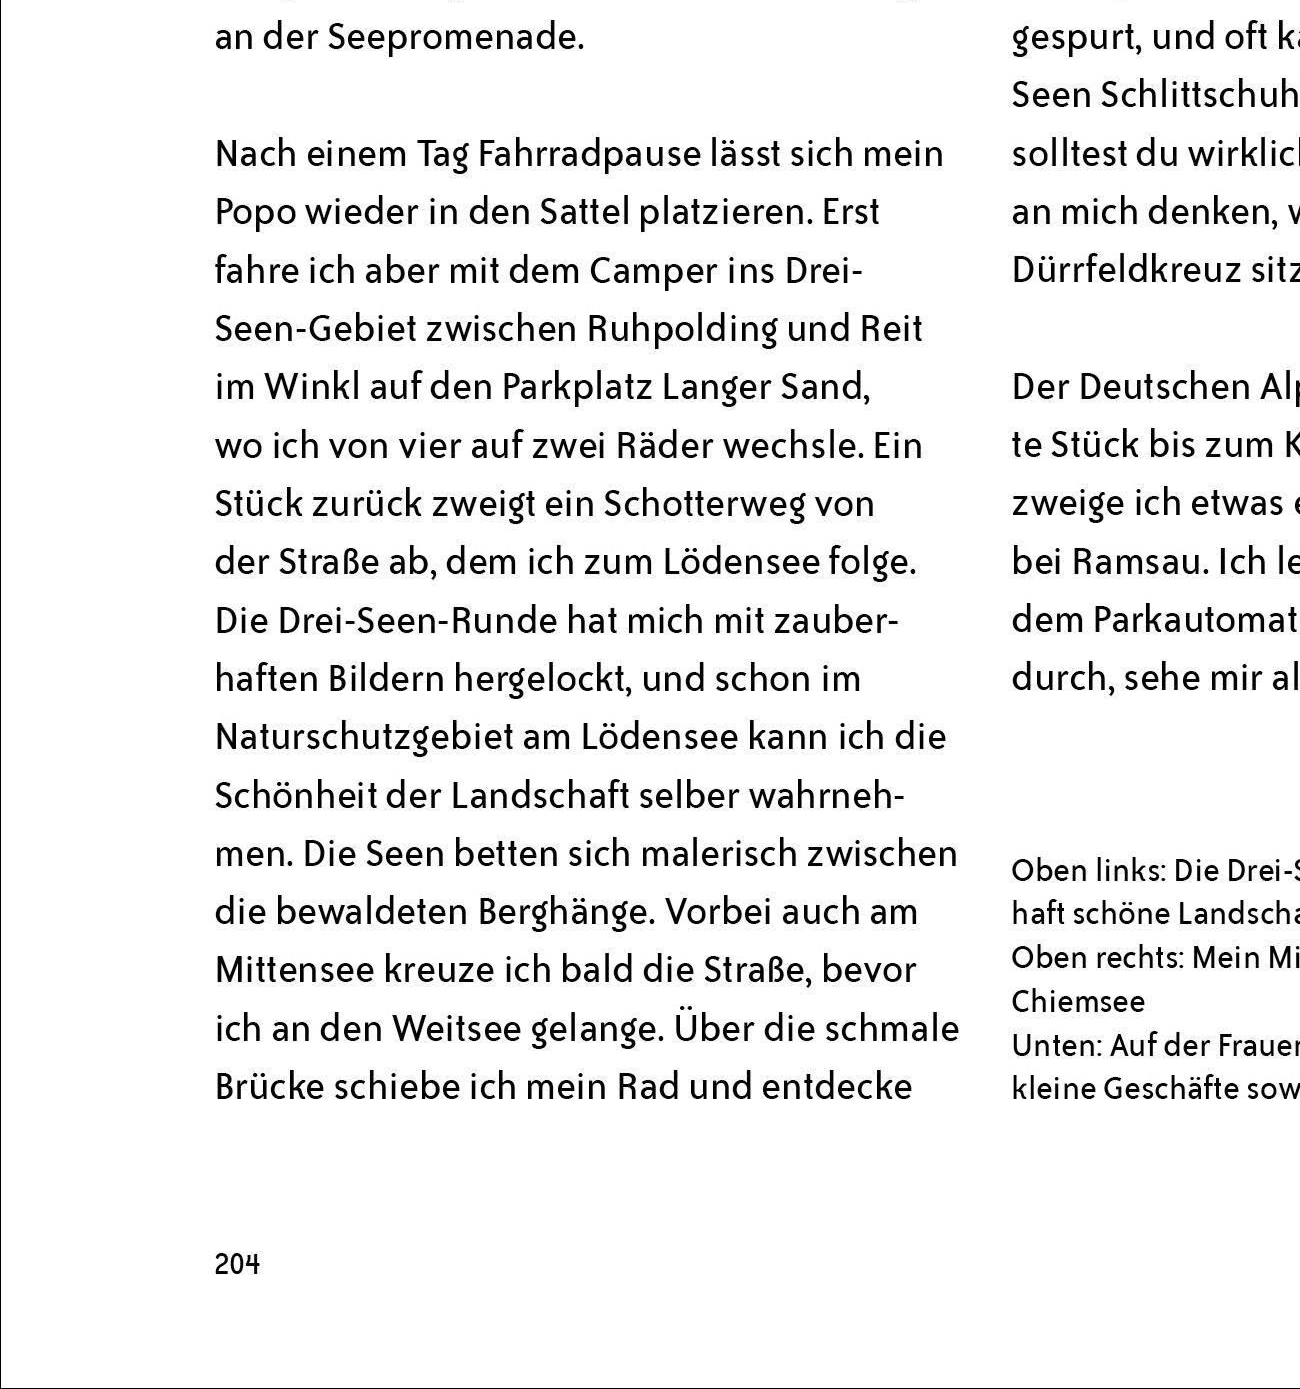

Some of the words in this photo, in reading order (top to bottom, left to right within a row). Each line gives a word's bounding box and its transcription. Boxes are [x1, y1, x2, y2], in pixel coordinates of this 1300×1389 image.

[1012, 80, 1091, 108] Seen
[215, 311, 417, 342] Seen-Gebiet
[426, 311, 576, 342] zwischen
[589, 311, 779, 350] Ruhpolding
[788, 311, 849, 342] und
[862, 314, 923, 342] Reit
[1011, 431, 1042, 458] te
[1051, 427, 1139, 458] Stück
[1150, 427, 1195, 458] bis
[1205, 437, 1273, 458] zum
[217, 719, 514, 758] Naturschutzgebiet
[523, 729, 570, 750] am
[583, 719, 738, 750] Lödensee
[749, 719, 827, 750] kann
[840, 719, 884, 750] ich
[895, 719, 946, 750] die
[1011, 856, 1087, 882] Oben
[1097, 856, 1166, 882] links:
[1175, 858, 1219, 882] Die
[1013, 898, 1065, 925] haft
[1073, 899, 1170, 925] schöne
[1011, 943, 1087, 969] Oben
[1097, 943, 1184, 969] rechts:
[1193, 945, 1260, 969] Mein
[1012, 987, 1145, 1013] Chiemsee
[1013, 1033, 1102, 1057] Unten:
[1109, 1030, 1159, 1057] Auf
[1164, 1031, 1211, 1057] der
[1013, 1074, 1096, 1100] kleine
[1103, 1073, 1239, 1100] Geschäfte
[215, 1252, 260, 1275] 204
